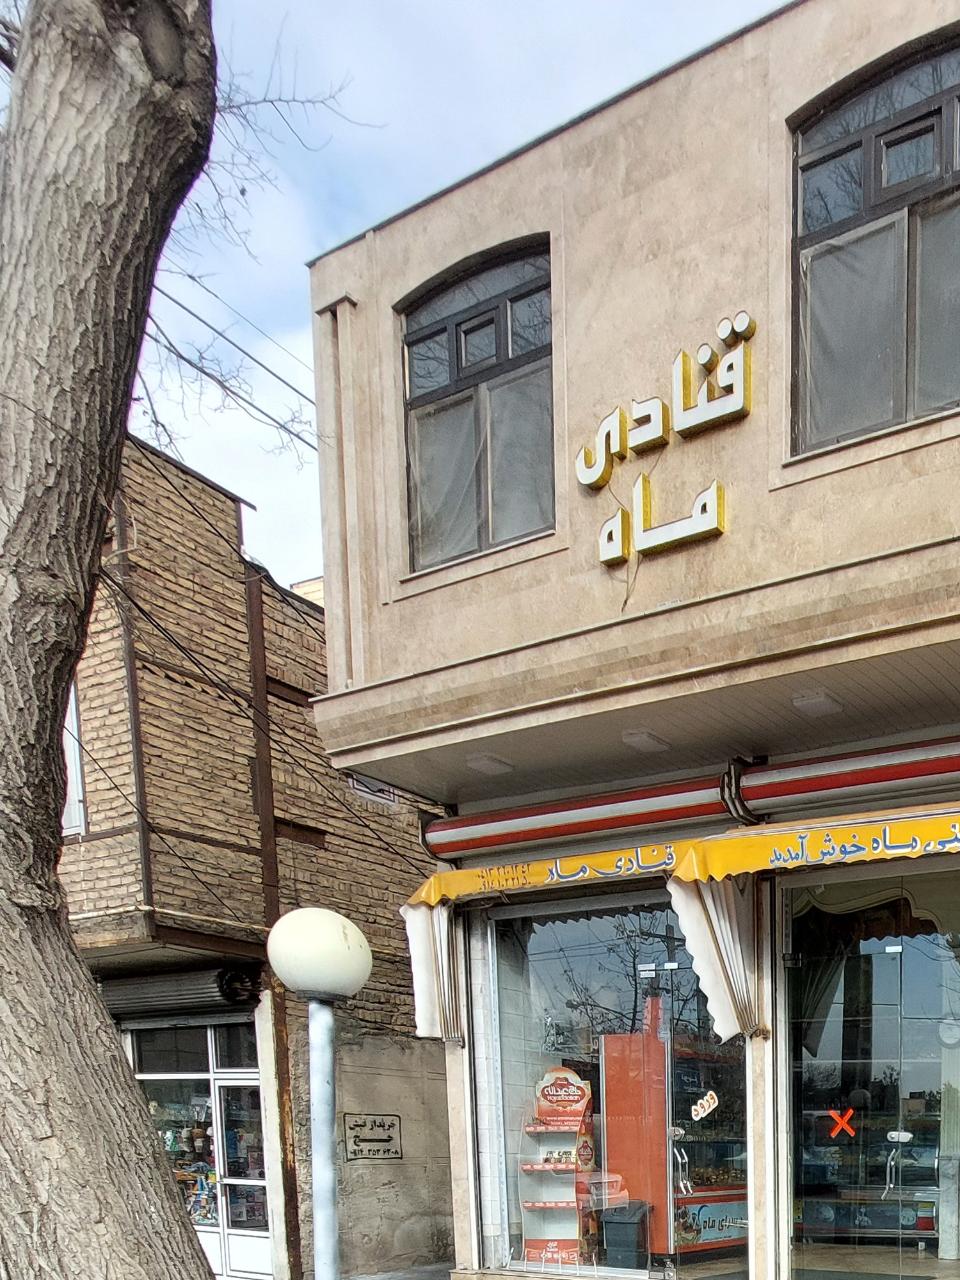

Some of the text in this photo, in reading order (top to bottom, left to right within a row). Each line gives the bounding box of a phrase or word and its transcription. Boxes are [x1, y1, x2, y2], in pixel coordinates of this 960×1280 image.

[575, 310, 757, 490] قنادی
[599, 472, 726, 566] ماه
[769, 834, 808, 867] آمدید
[806, 834, 867, 865] خوش
[871, 826, 920, 853] ماه
[545, 845, 676, 883] قنادی ماه
[692, 1091, 718, 1121] ورود
[368, 1118, 396, 1130] خریدار
